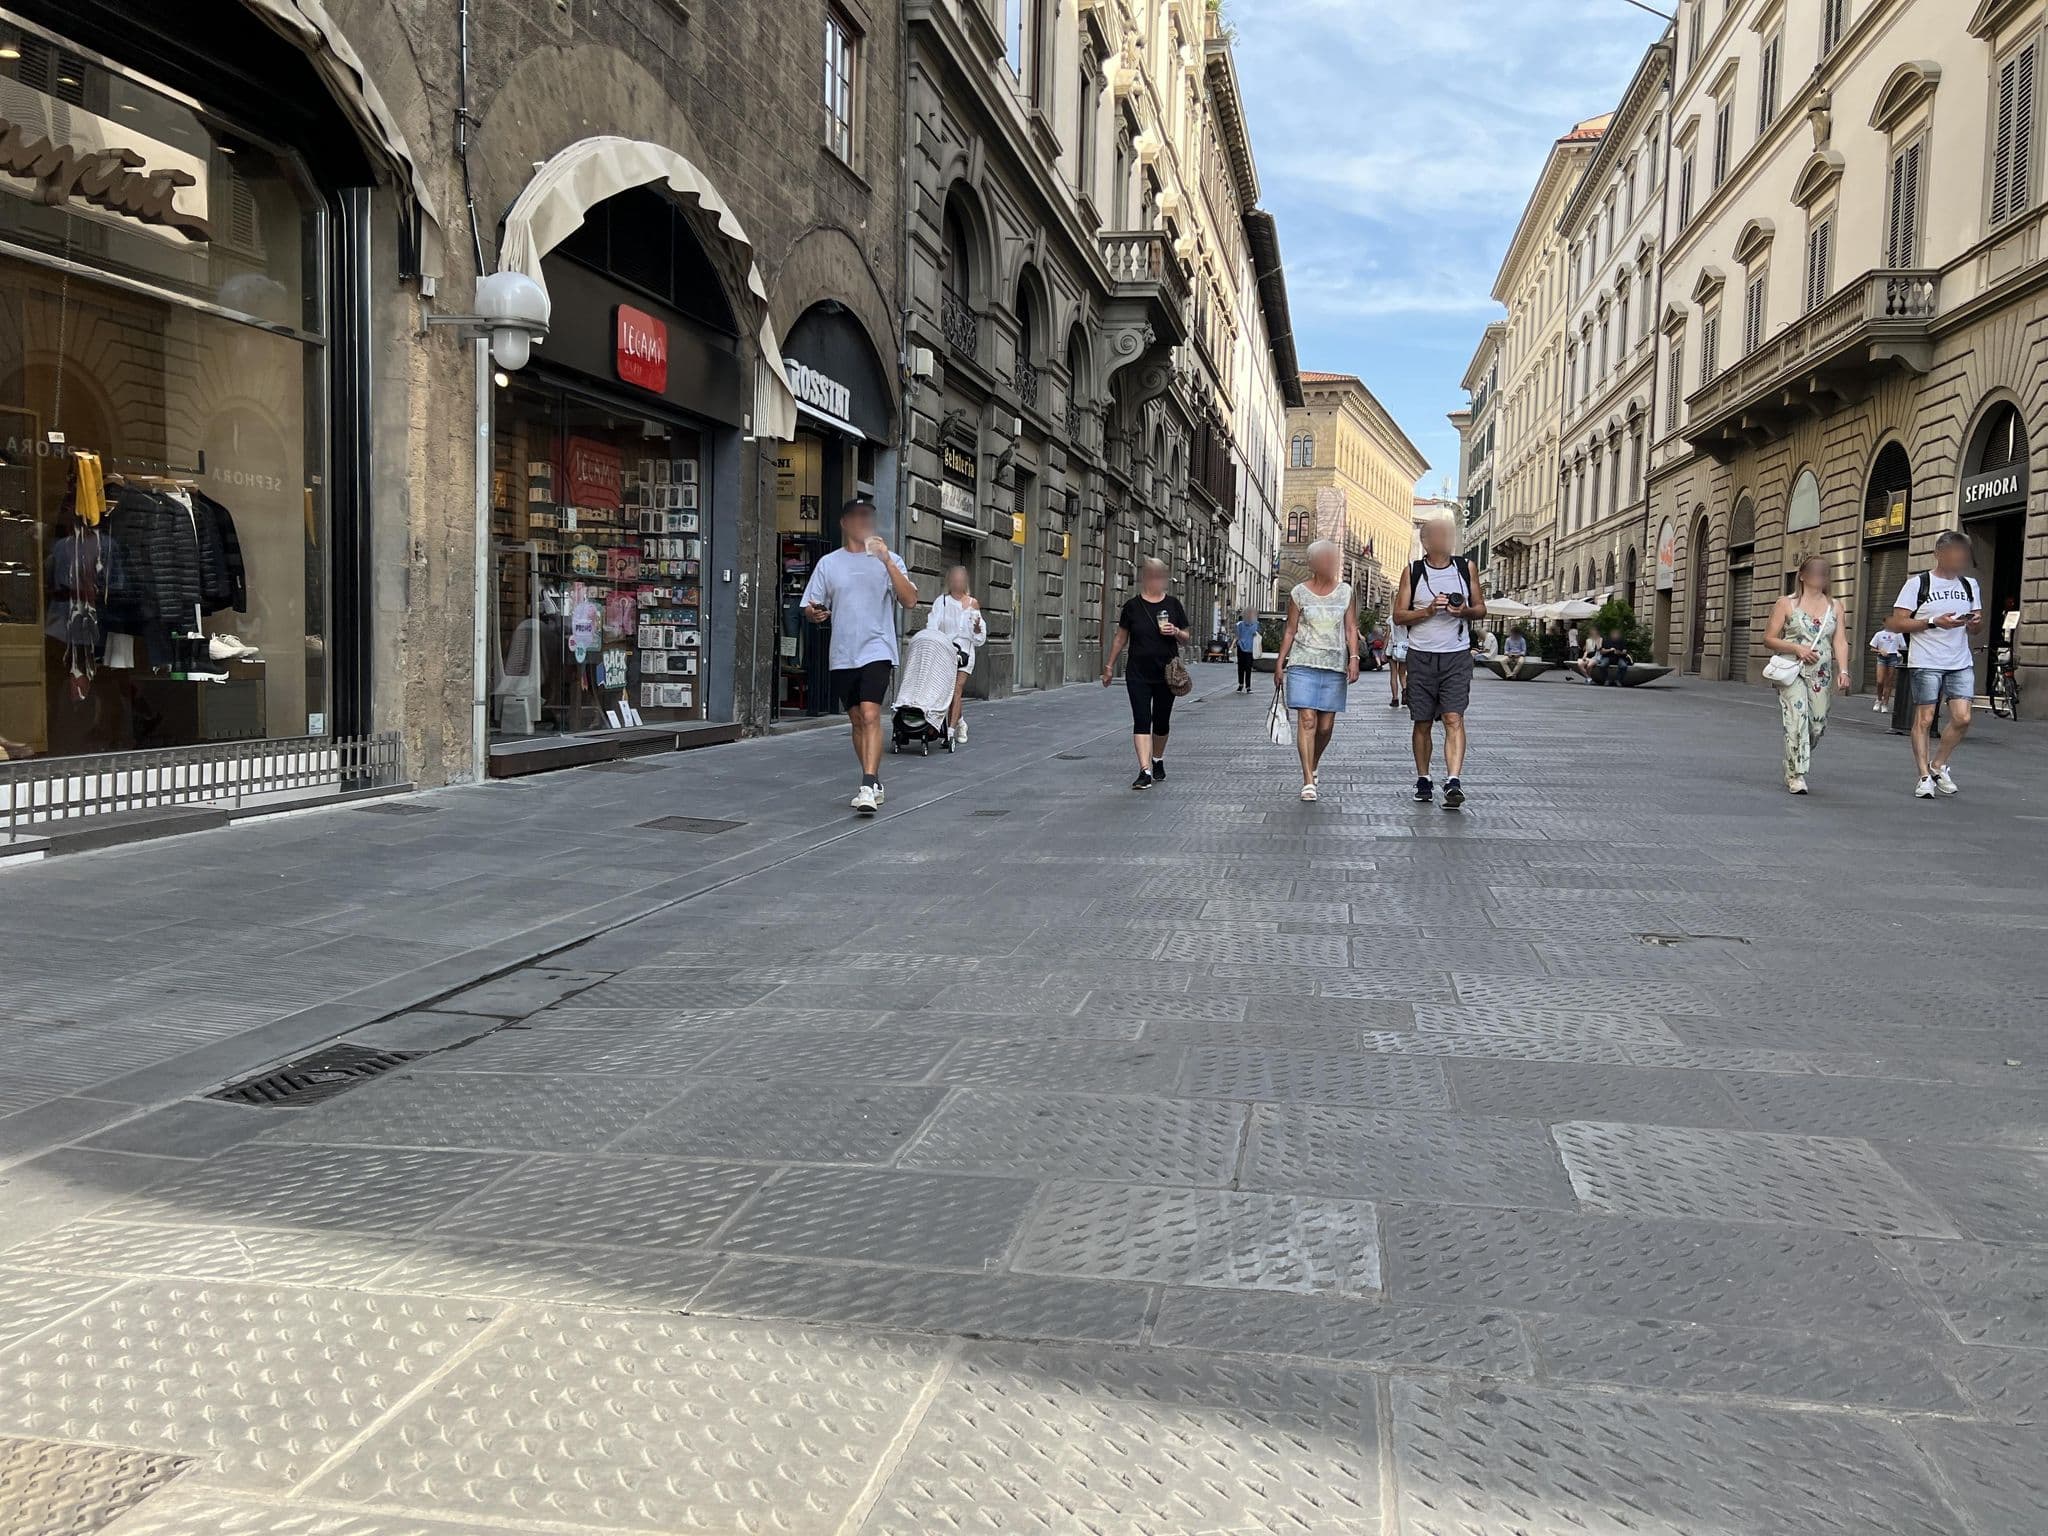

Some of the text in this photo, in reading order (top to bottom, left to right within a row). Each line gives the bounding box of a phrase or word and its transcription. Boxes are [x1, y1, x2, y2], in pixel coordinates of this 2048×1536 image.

[623, 321, 663, 365] LEGAMI
[1965, 475, 2018, 503] SEPHORA
[1927, 590, 1970, 603] ILFIGE
[603, 650, 627, 671] BACK
